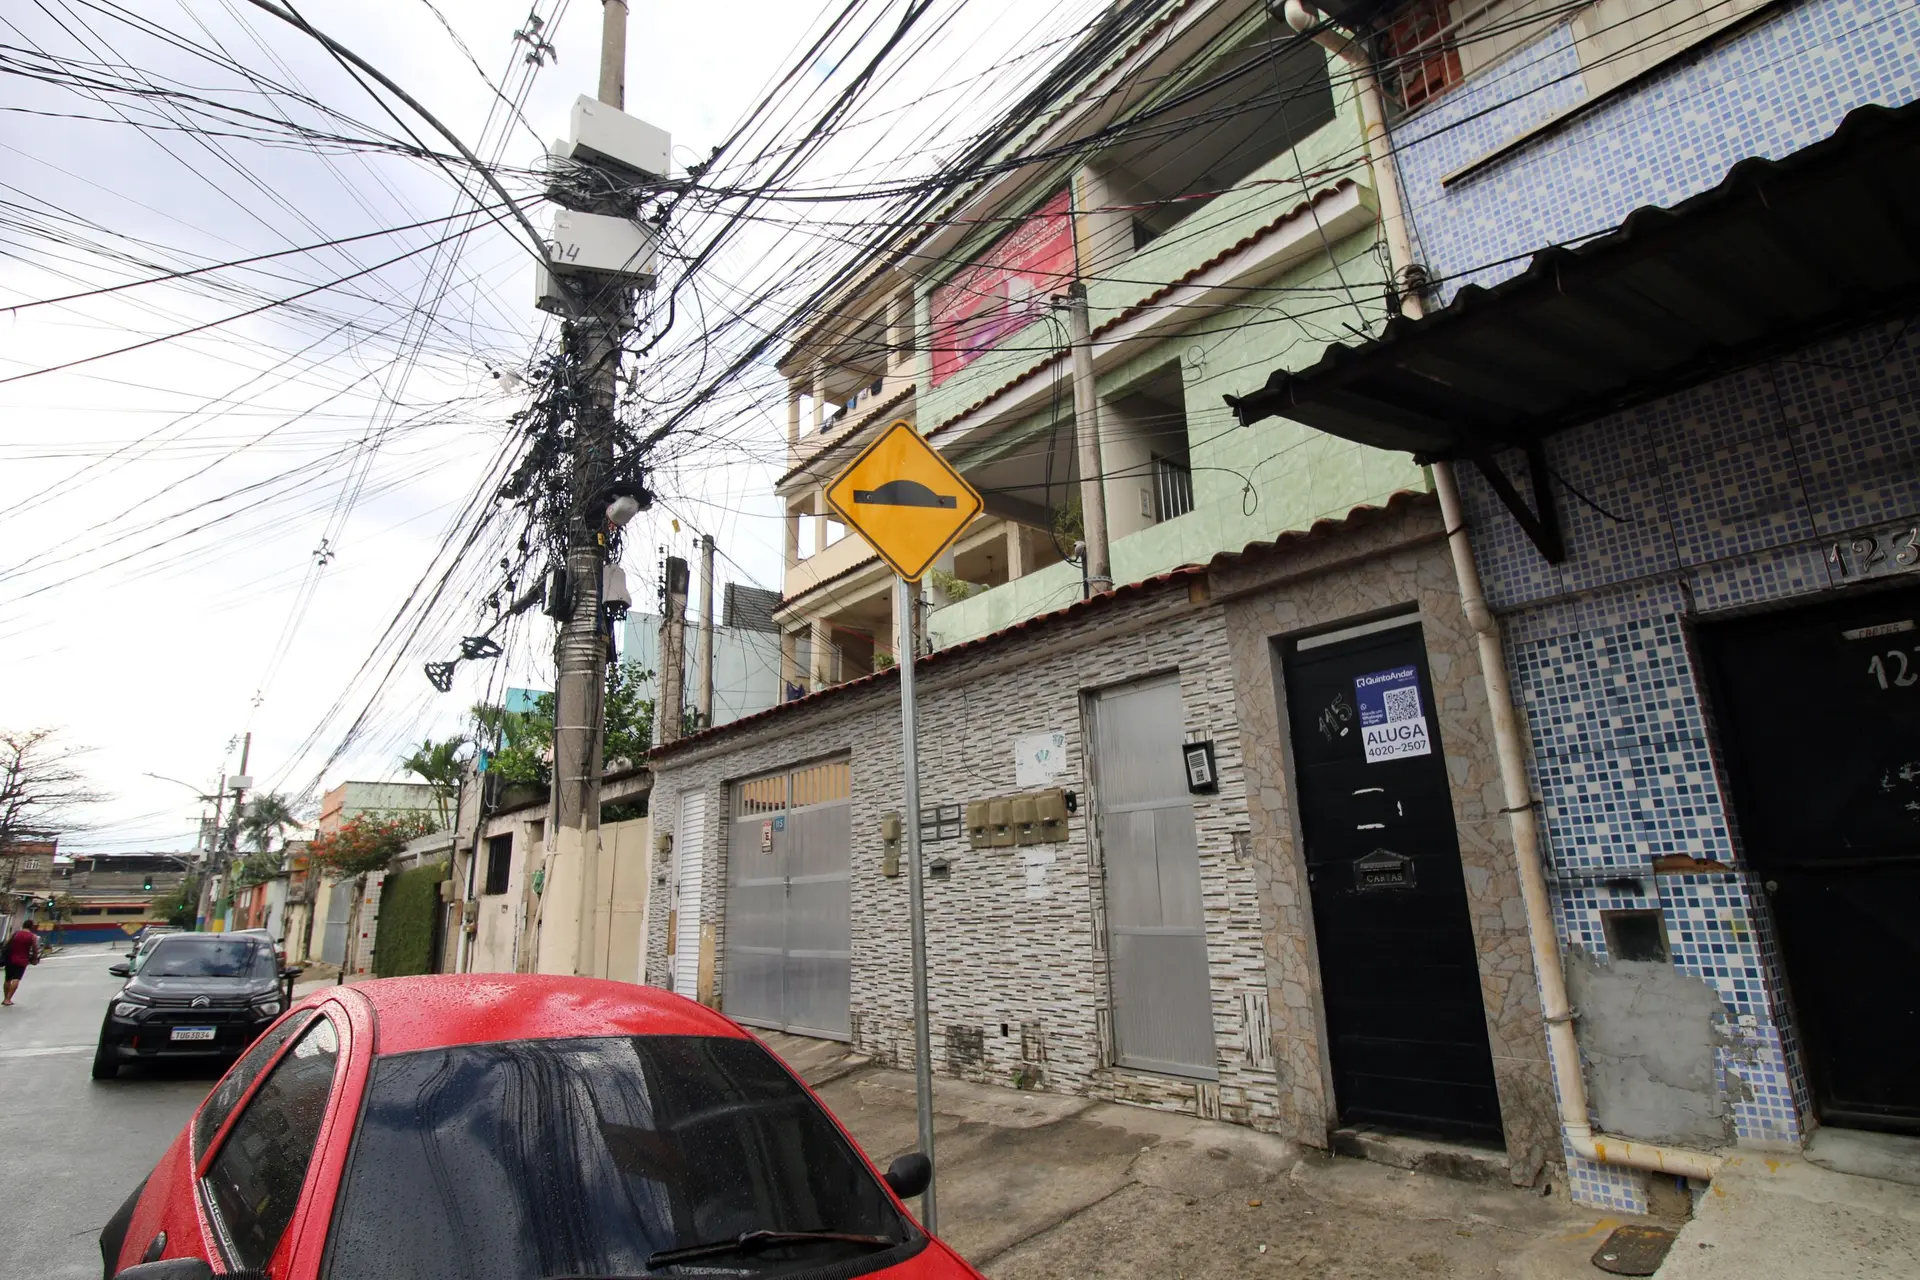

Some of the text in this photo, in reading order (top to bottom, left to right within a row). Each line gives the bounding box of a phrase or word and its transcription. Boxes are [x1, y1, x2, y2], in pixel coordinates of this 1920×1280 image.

[1829, 527, 1920, 577] 123
[1366, 669, 1414, 686] QuintoAndar
[1867, 646, 1920, 690] 12
[1319, 692, 1353, 741] 115
[1367, 724, 1425, 746] ALUGA
[1368, 740, 1426, 757] 4020-2507
[1366, 872, 1402, 883] CARTAS
